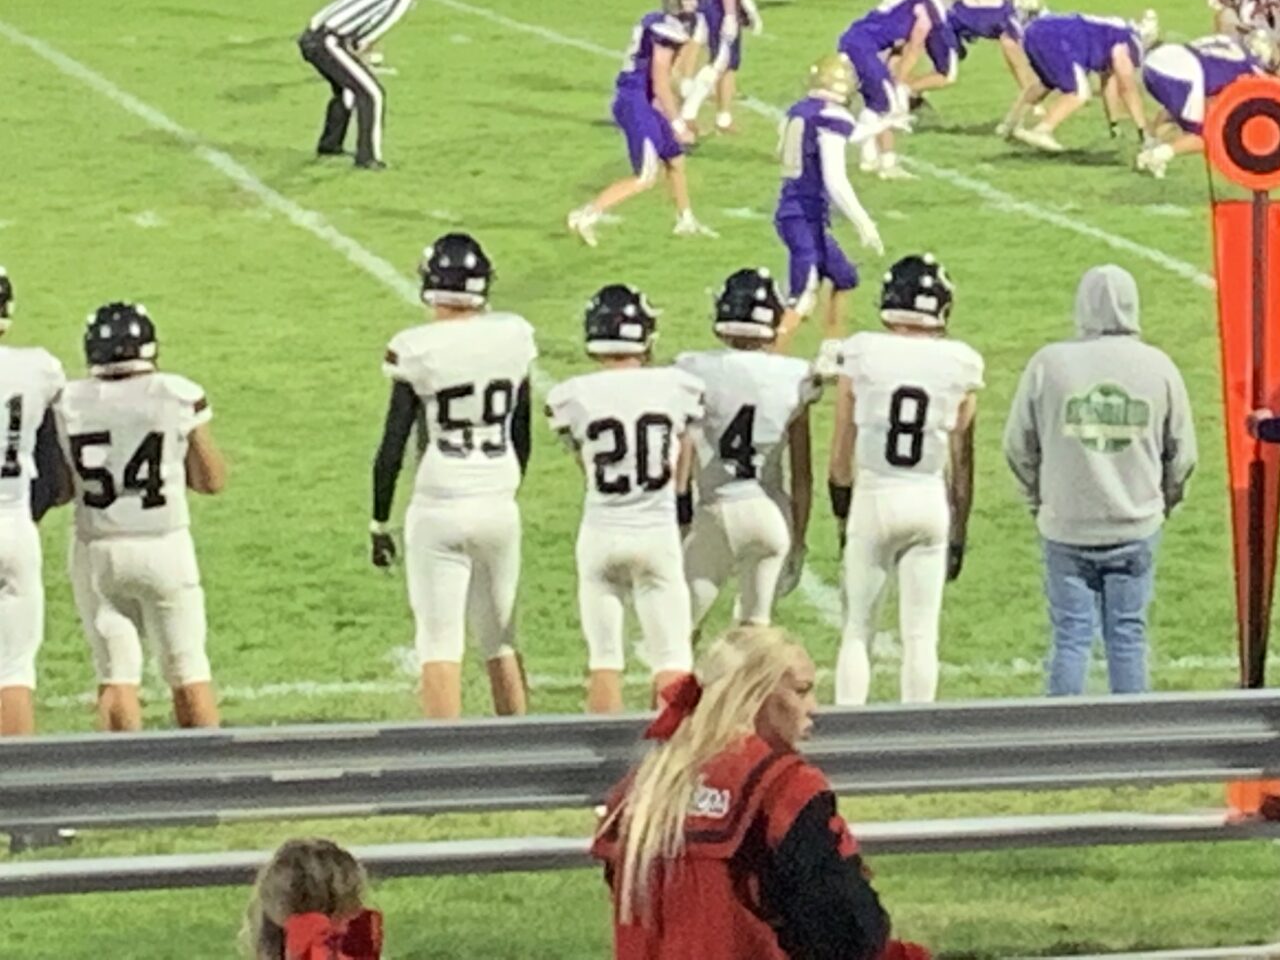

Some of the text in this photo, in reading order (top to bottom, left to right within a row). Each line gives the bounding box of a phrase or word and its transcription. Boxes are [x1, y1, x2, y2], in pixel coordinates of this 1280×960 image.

[435, 378, 514, 458] 59
[586, 413, 674, 495] 20
[719, 404, 756, 479] 4
[885, 384, 930, 469] 8
[70, 430, 166, 510] 54
